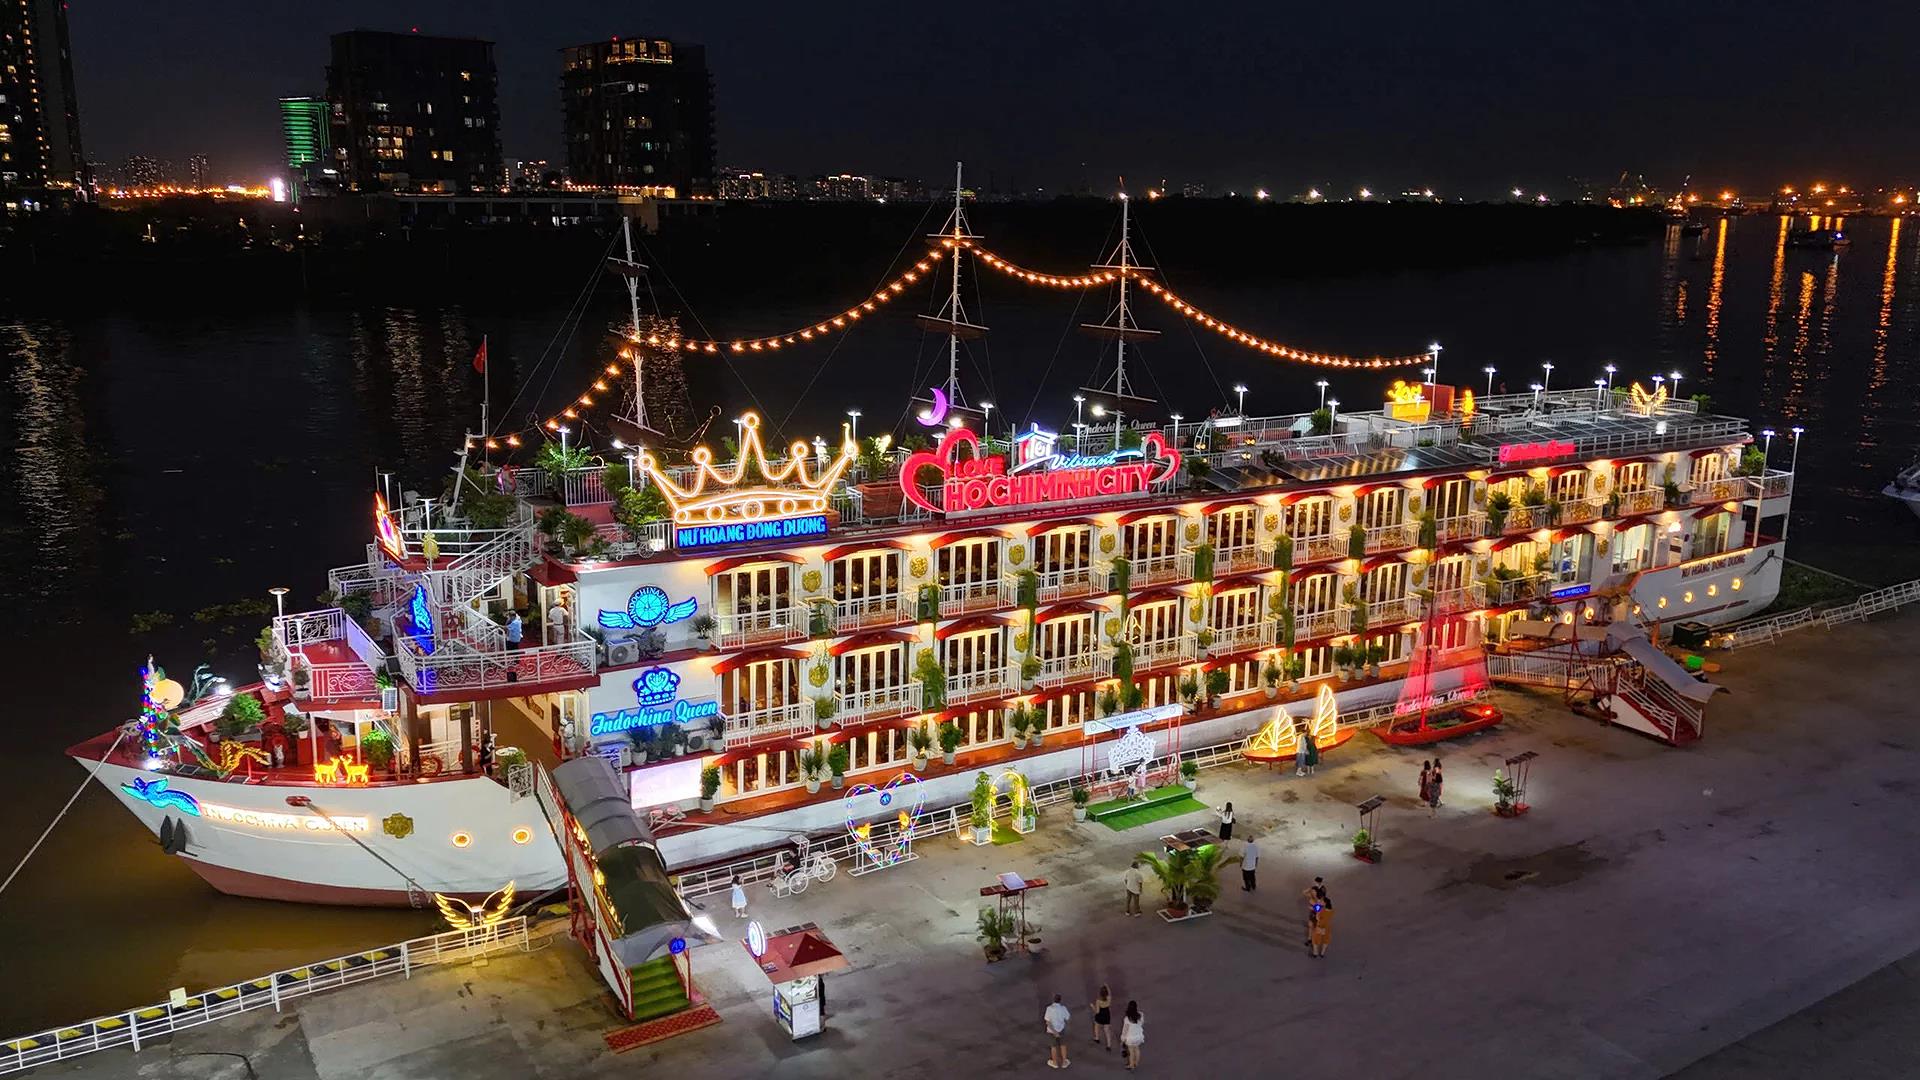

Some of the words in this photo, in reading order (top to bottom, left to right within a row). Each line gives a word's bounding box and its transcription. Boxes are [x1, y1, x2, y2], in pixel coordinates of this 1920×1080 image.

[1050, 449, 1143, 470] Vibrant
[591, 708, 672, 735] Indochina
[675, 699, 718, 723] Queen
